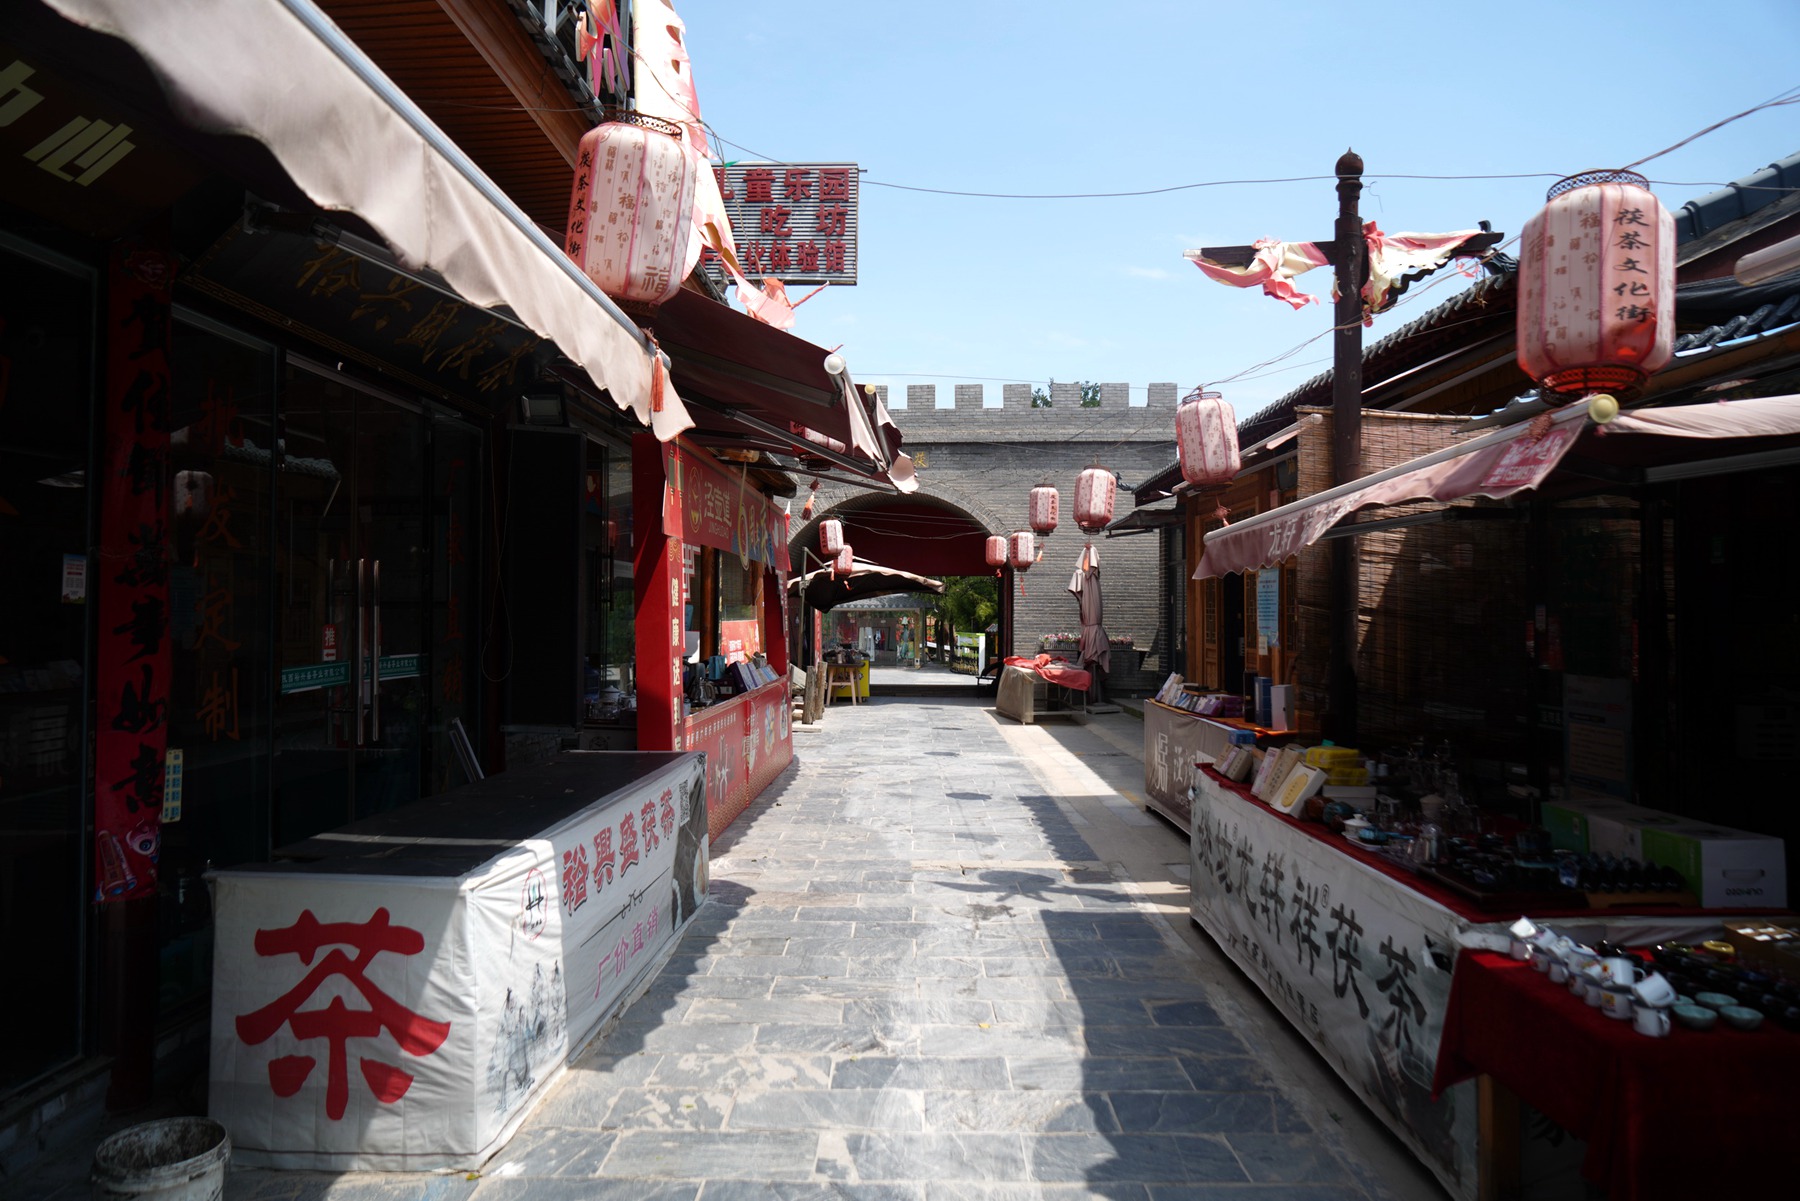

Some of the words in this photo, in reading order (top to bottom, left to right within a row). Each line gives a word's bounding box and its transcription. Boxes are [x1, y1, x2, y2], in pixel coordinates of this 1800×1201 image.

[568, 151, 591, 258] 茯茶文化街
[713, 168, 850, 203] 儿童乐园
[728, 203, 849, 237] 吃坊
[700, 238, 848, 277] 化体验馆
[1614, 208, 1653, 323] 茯茶文化街
[191, 377, 244, 742] 批发定制
[325, 628, 335, 646] 推
[595, 904, 660, 999] 厂价直销
[235, 906, 451, 1121] 茶
